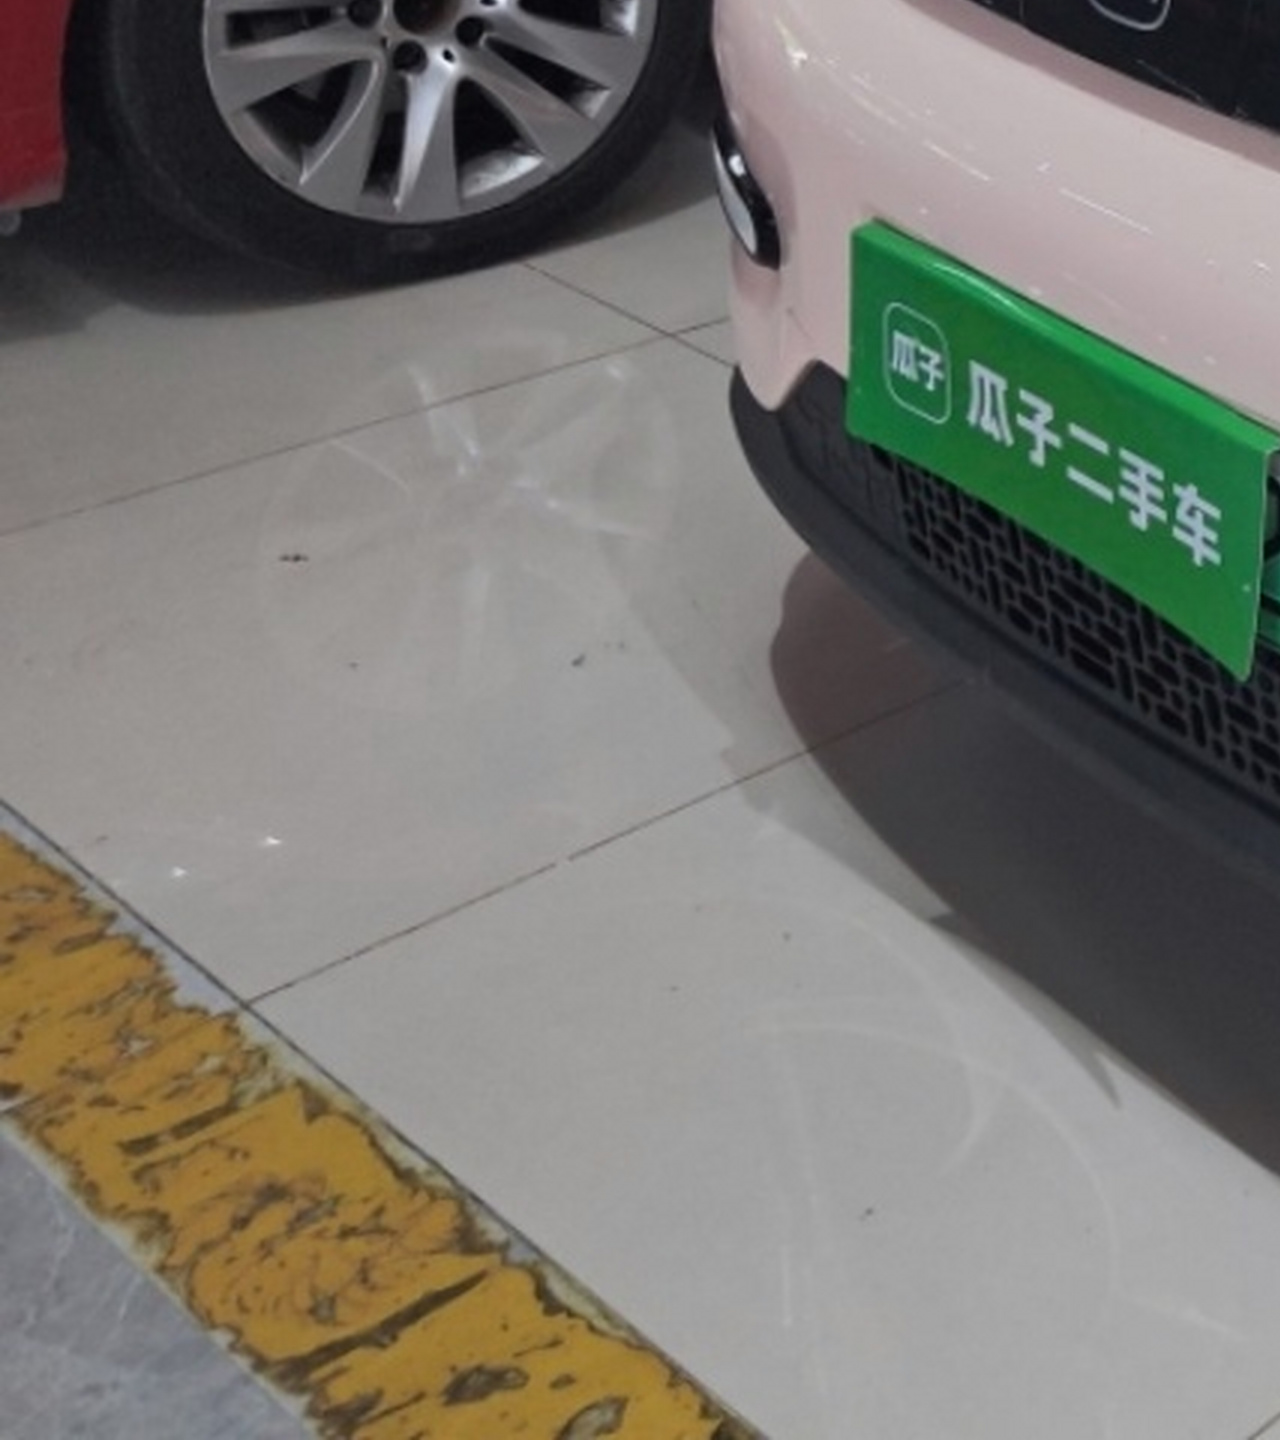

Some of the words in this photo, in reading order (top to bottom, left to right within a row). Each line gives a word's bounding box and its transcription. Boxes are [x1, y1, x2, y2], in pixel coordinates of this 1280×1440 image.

[891, 329, 945, 392] 瓜子
[966, 359, 1222, 567] 瓜子二手车
